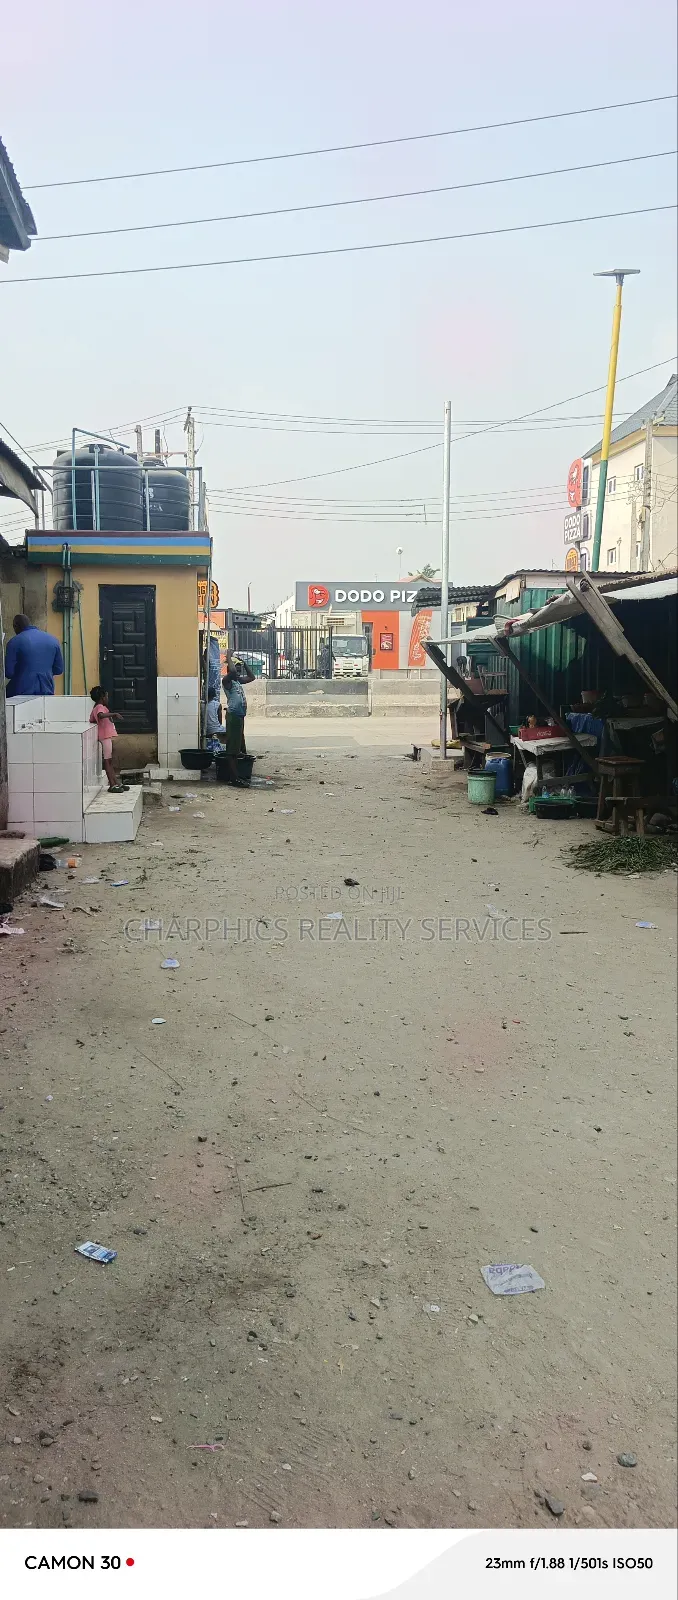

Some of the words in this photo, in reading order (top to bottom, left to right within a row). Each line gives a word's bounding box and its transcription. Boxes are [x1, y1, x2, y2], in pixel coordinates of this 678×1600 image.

[564, 513, 581, 530] DODO
[564, 526, 581, 542] PIZZA
[335, 589, 385, 603] DODO
